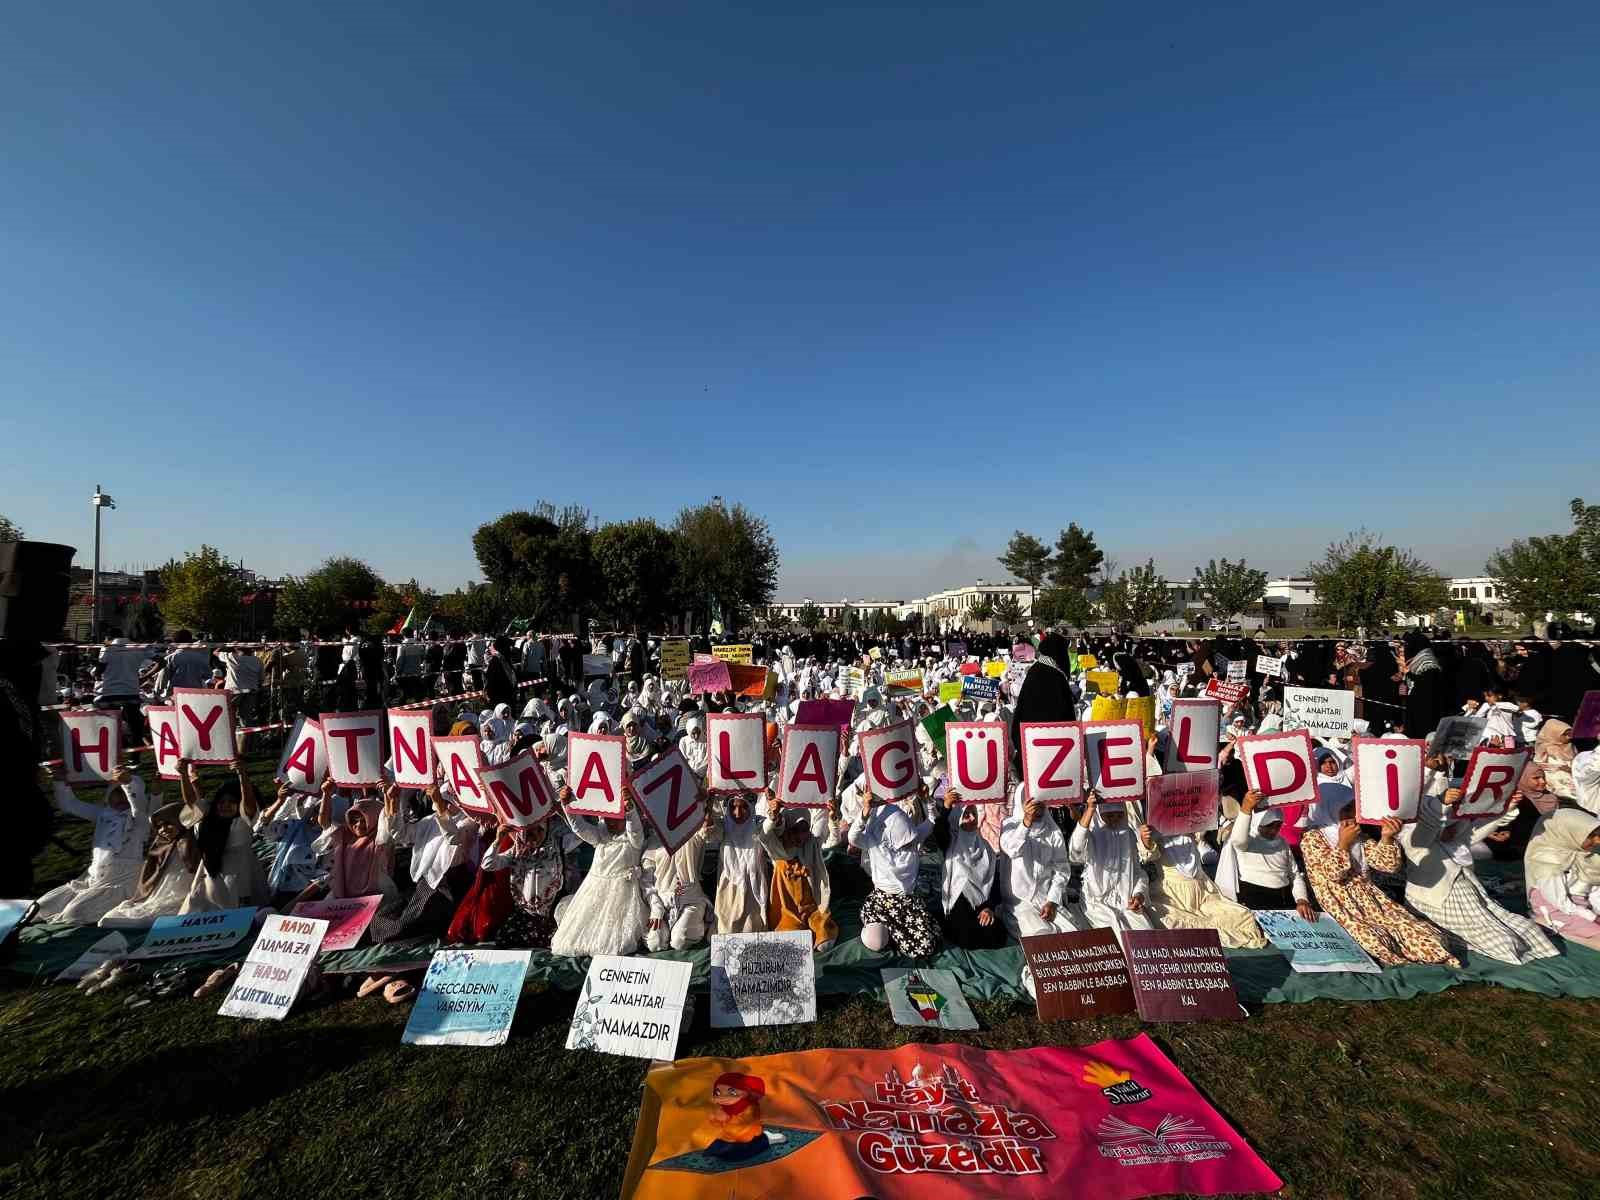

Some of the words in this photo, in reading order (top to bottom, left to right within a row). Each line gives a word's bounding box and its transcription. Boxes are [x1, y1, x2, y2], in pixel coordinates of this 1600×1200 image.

[1304, 719, 1349, 730] NAMAZDIR
[181, 914, 227, 928] HAYAT
[256, 938, 312, 955] NAMAZA
[1072, 946, 1107, 959] NAMAZINI
[1172, 946, 1209, 958] NAMAZINI
[599, 968, 651, 985] CENNETİN
[1043, 981, 1058, 993] SEN
[1140, 980, 1156, 991] SEN
[1194, 977, 1230, 992] BAŞBAŞA
[610, 992, 665, 1009] ANAHTARI
[1080, 993, 1096, 1005] KAL
[1181, 995, 1198, 1006] KAL
[600, 1018, 671, 1041] NAMAZDIR
[875, 1079, 979, 1108] Hayat
[823, 1100, 1057, 1141] Namazla
[857, 1131, 1045, 1175] Güzeldir
